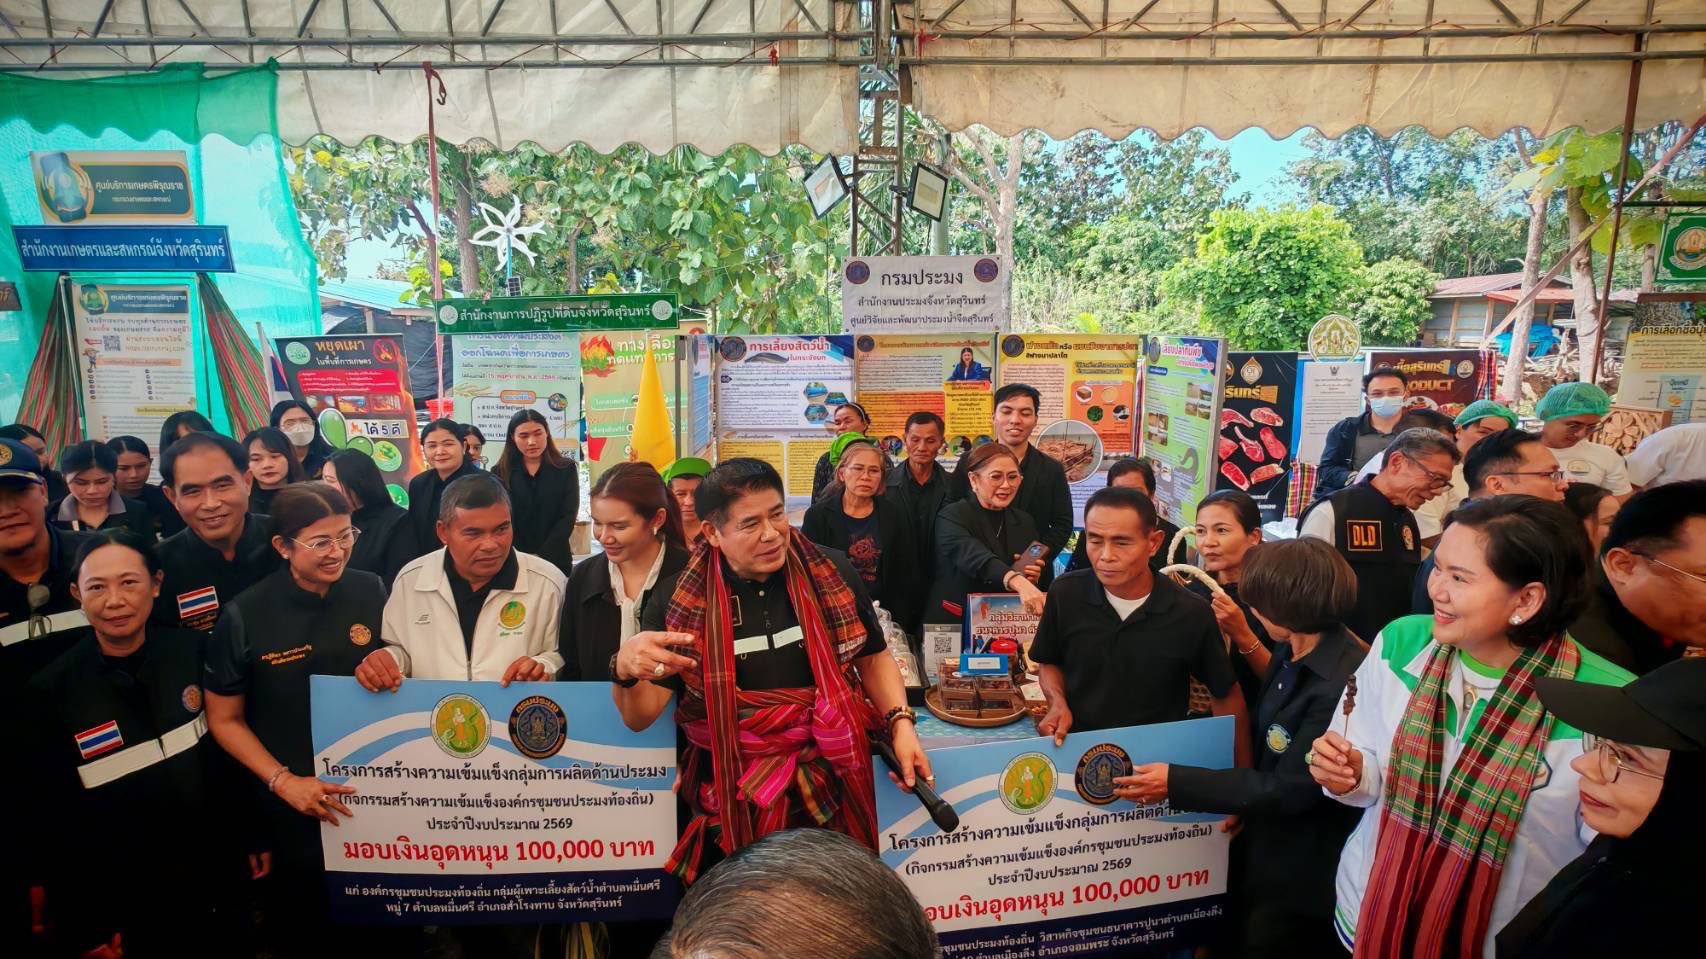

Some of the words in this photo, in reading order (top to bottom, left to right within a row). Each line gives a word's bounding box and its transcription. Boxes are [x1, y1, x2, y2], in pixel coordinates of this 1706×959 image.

[21, 238, 225, 263] สำนักงานเกษตรและสหกรณ์จังหวัดสุรินทร์
[881, 269, 963, 287] กรมประมง
[858, 295, 986, 308] สำนักงานประมงจังหวัดสุรินทร์
[459, 302, 650, 325] สำนักงานการปฏิรูปที่ดินจังหวัดสุรินทร์
[850, 313, 994, 327] ศูนย์วิจัยและพัฒนาประมงน้ำจืดสุรินทร์
[315, 340, 365, 356] หยุดเผา
[749, 337, 830, 352] การเลี้ยงสัตว์น้ำ
[1224, 384, 1261, 400] รินทร์
[1406, 379, 1455, 391] ODUCT
[364, 422, 378, 435] ได้
[381, 425, 388, 435] 5
[392, 423, 401, 435] ดี
[1352, 525, 1376, 546] DLD
[323, 758, 667, 786] โครงการสร้างความเข้มแข็งกลุ่มการผลิตด้านประมง
[339, 787, 654, 811] (กจกรรมสร้างความเข้มแข็งองค์กรชุมชนประมงท้องถิ่น)
[426, 815, 540, 830] ประจำปีงบประมาณ
[543, 818, 573, 830] 2569
[889, 799, 1177, 850] โครงการสร้างความเข้มแข็งกลุ่มการผลิตด้า
[344, 835, 508, 869] มอบเงินอุดหนุน
[516, 839, 604, 863] 100,000
[609, 840, 655, 858] บาท
[905, 824, 1212, 876] (กิจกรรมสร้างความเข้มแข็งองค์กรชุมชนประมงท้องถิ่น)
[988, 862, 1099, 886] ประจำปีงบประมาณ
[1102, 857, 1132, 872] 2569
[345, 884, 360, 896] แก่
[362, 882, 491, 900] องค์กรชุมชนประมงท้องถิ่น
[493, 877, 661, 900] กลุ่มผู้เพาะเลี้ยงสัตว์น้ำตำบลหมื่นศรี
[924, 890, 1064, 921] อบเงินอุดหนุน
[1072, 873, 1160, 904] 100,000
[1166, 868, 1209, 890] บาท
[386, 900, 401, 916] หมู่
[404, 903, 410, 912] 7
[412, 897, 475, 912] ตำบลหมื่นศรี
[477, 898, 555, 912] อำเภอสำโรงทาบ
[557, 896, 622, 912] จังหวัดสุรินทร์
[1111, 927, 1175, 946] จังหวัดสุรินทร์
